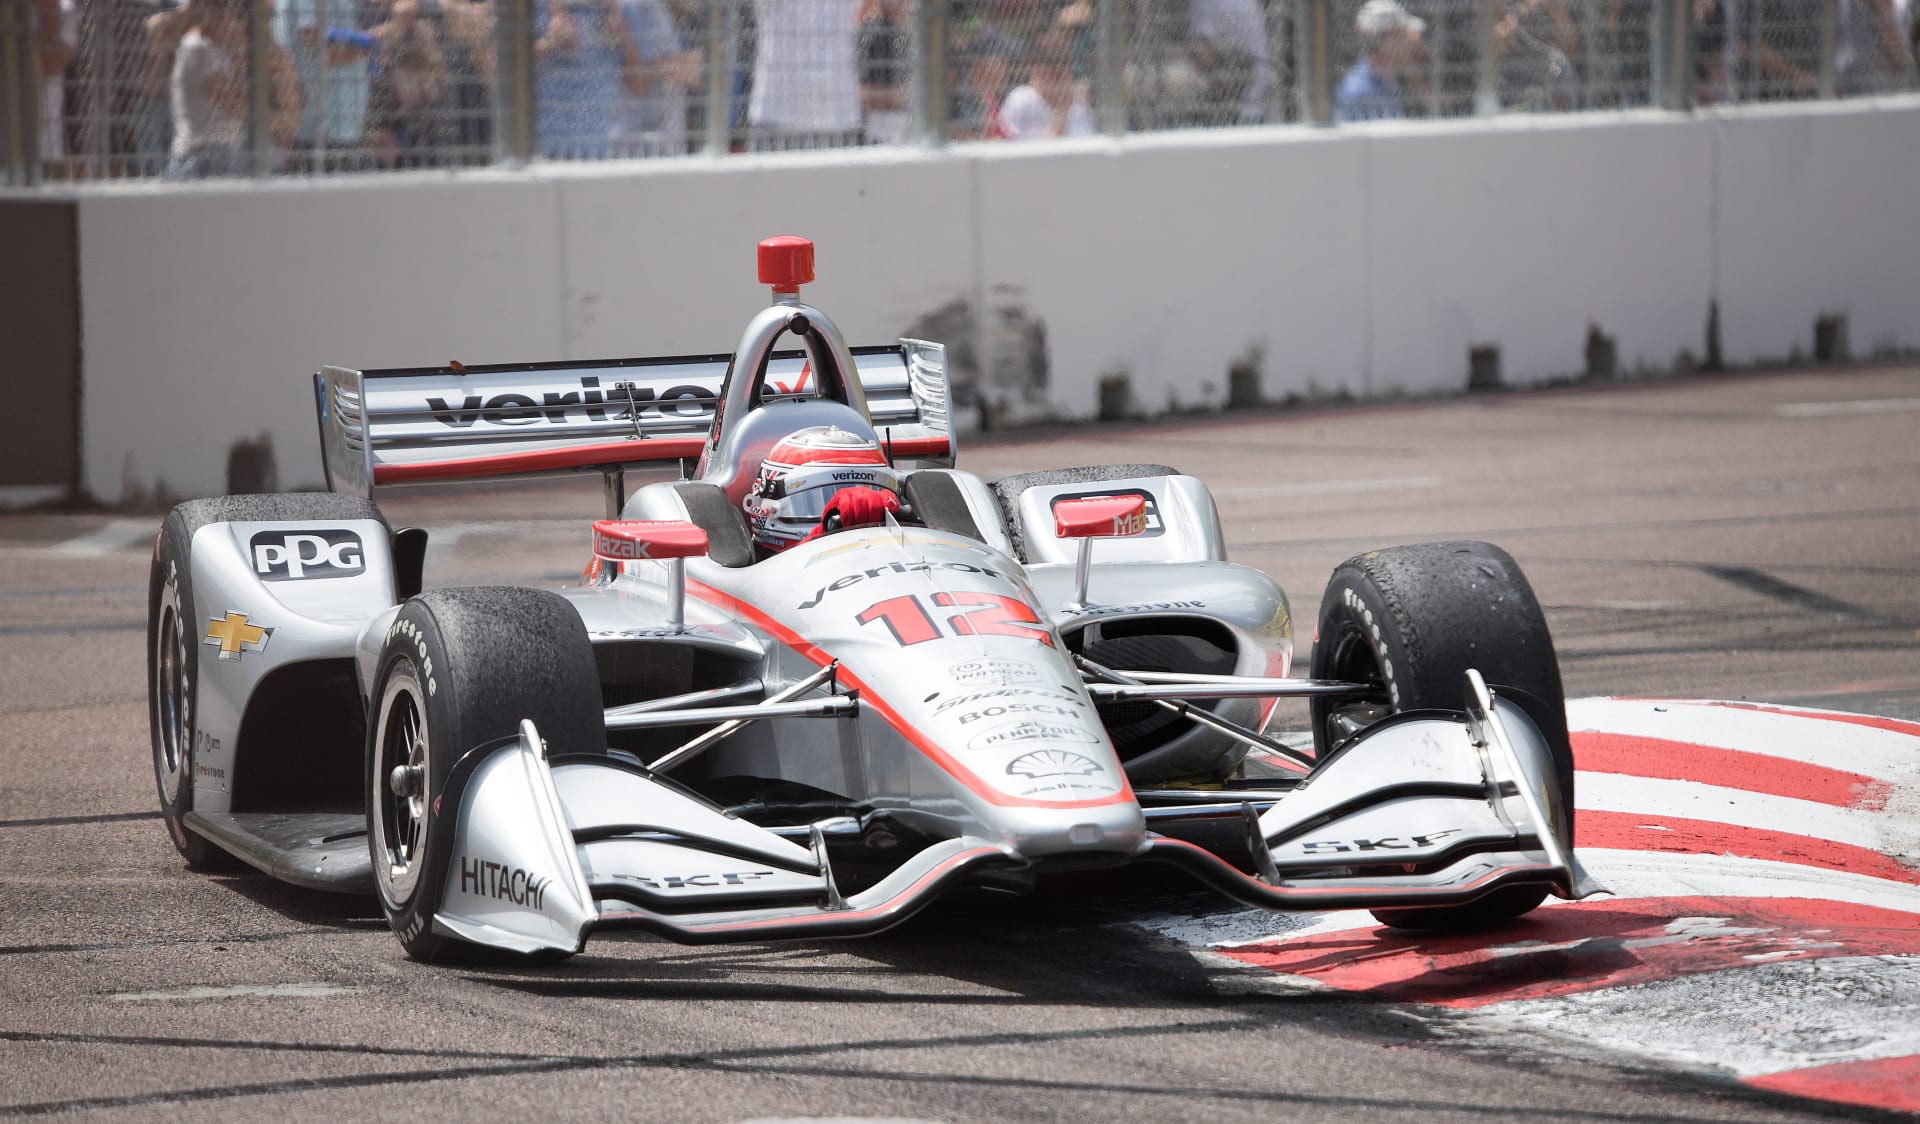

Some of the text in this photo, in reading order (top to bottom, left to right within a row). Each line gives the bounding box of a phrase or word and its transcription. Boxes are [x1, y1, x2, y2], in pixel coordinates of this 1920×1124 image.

[831, 470, 874, 481] verizon
[254, 534, 362, 578] PPG
[594, 531, 652, 559] Mazak
[855, 590, 1057, 649] 12
[958, 703, 1081, 725] BOSCH
[986, 724, 1082, 744] PENNZOIL
[1302, 829, 1463, 854] SKF
[461, 855, 553, 912] HITACHI
